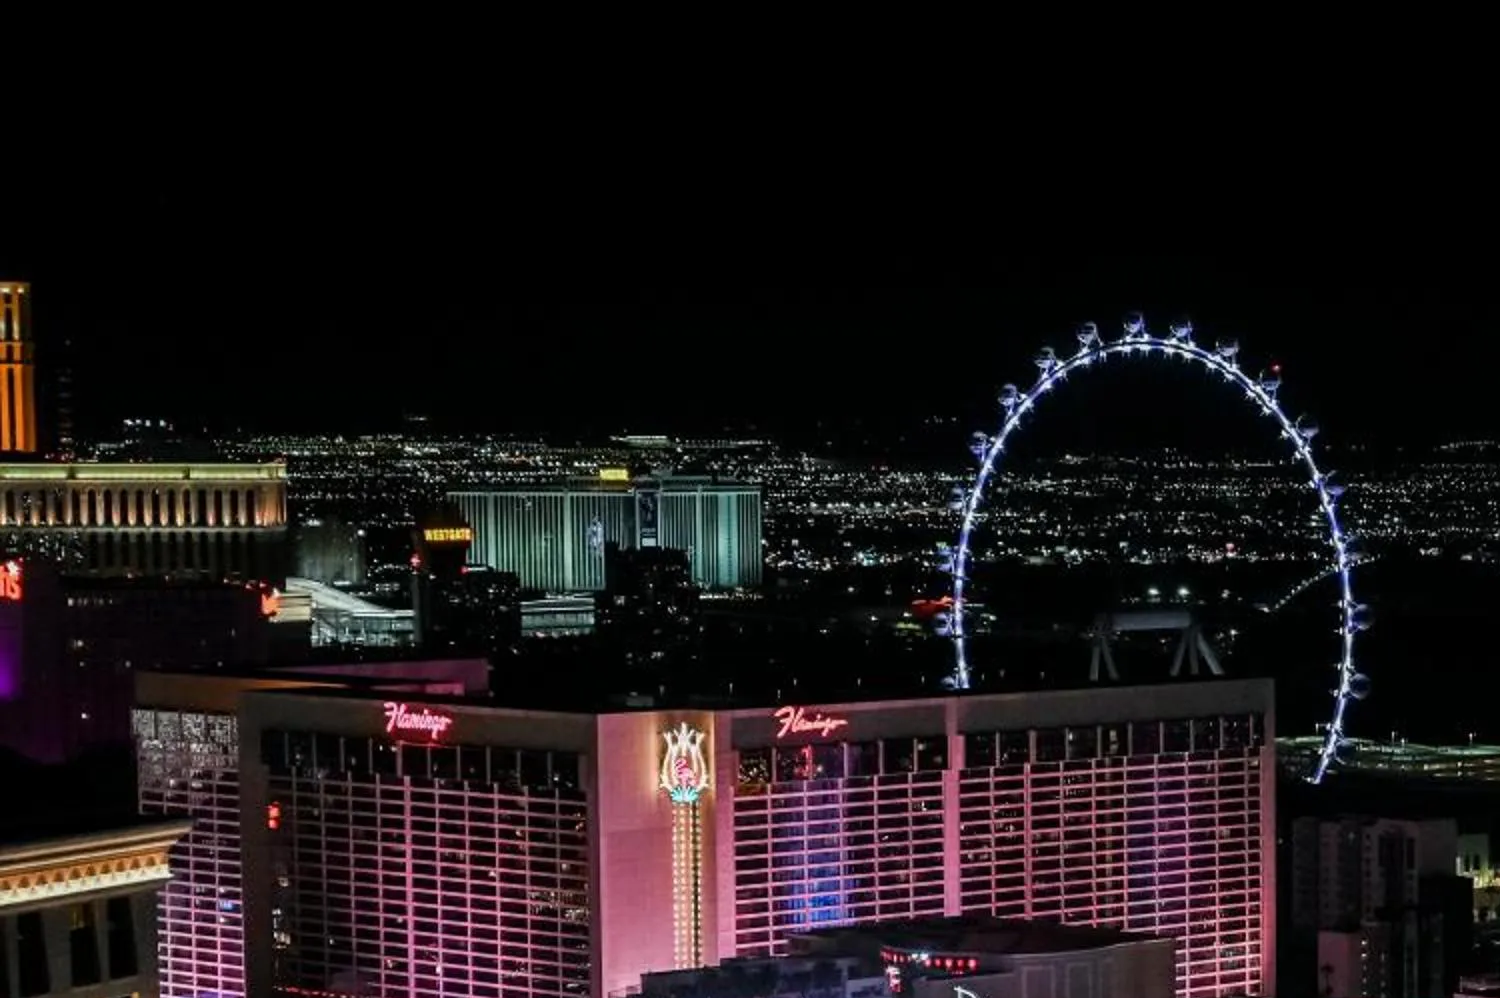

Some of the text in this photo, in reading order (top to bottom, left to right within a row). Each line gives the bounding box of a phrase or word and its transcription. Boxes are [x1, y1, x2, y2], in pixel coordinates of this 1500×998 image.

[423, 528, 471, 541] WESTGATE
[383, 701, 452, 740] Flamingo
[774, 705, 848, 738] Flamingo
